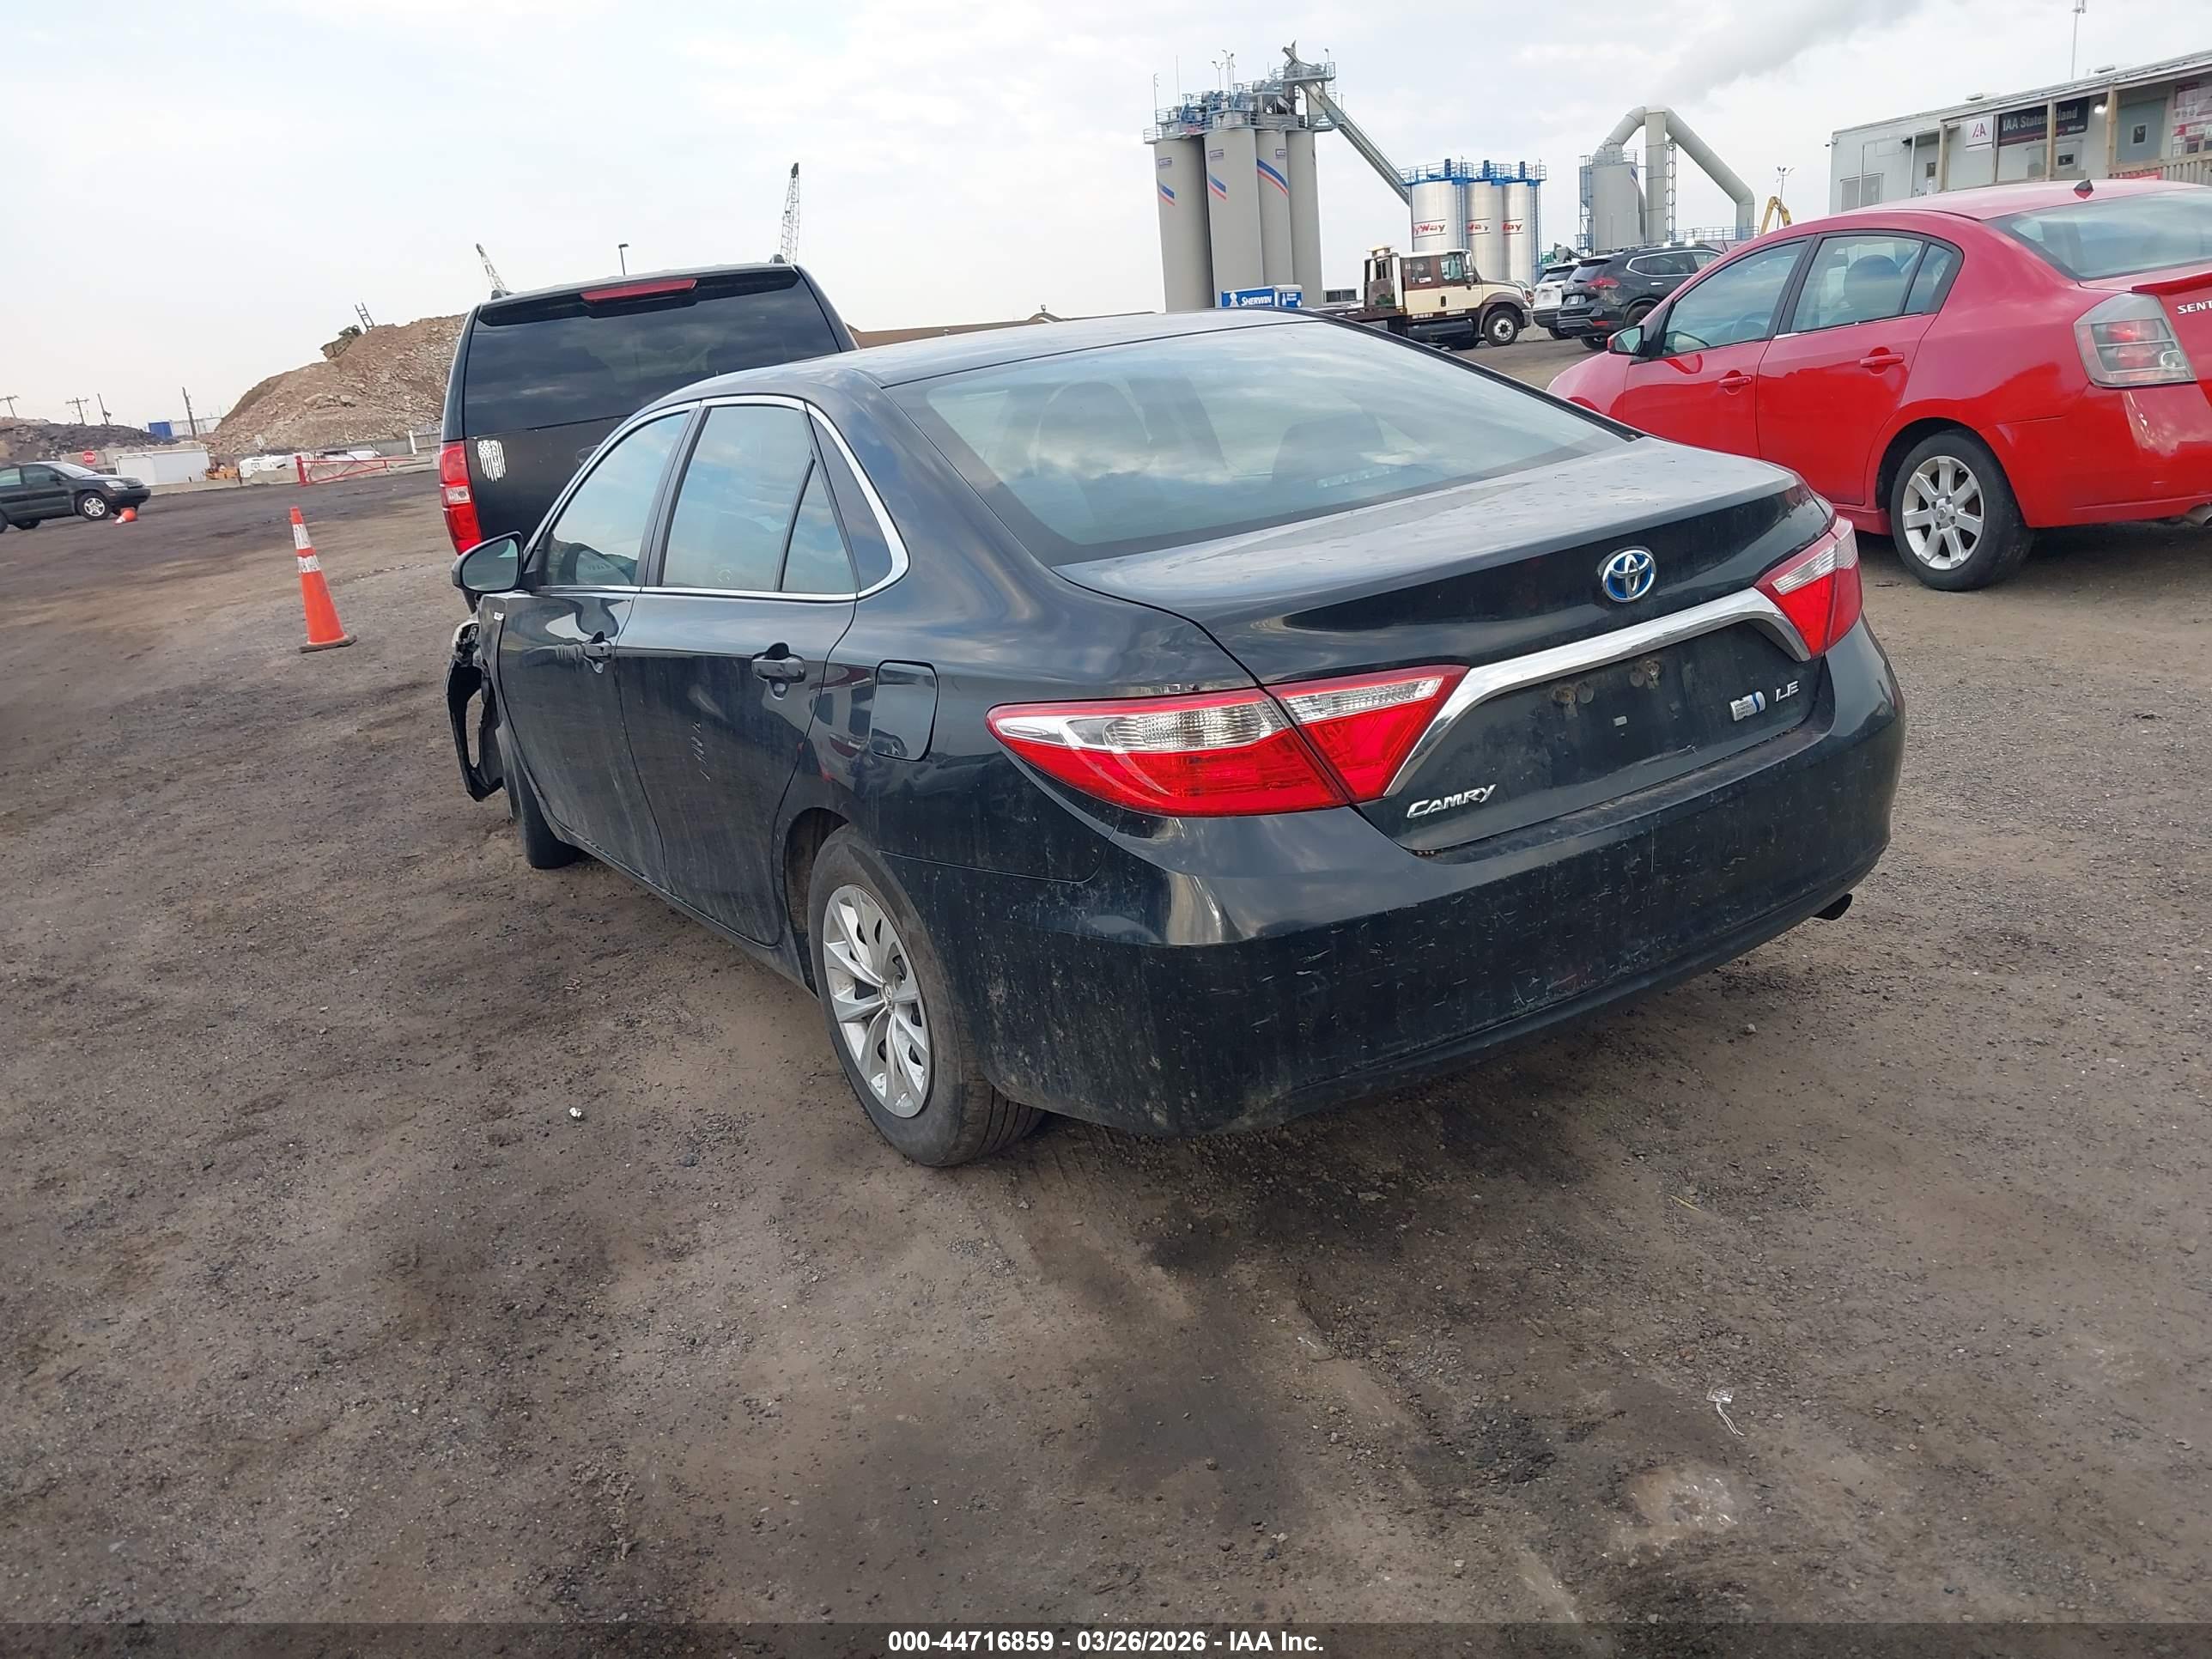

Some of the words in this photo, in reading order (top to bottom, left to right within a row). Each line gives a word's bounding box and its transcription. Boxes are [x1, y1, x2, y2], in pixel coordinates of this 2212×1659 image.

[2002, 118, 2019, 131] IAA
[1775, 680, 1800, 702] LE
[1407, 783, 1497, 818] CAMRY
